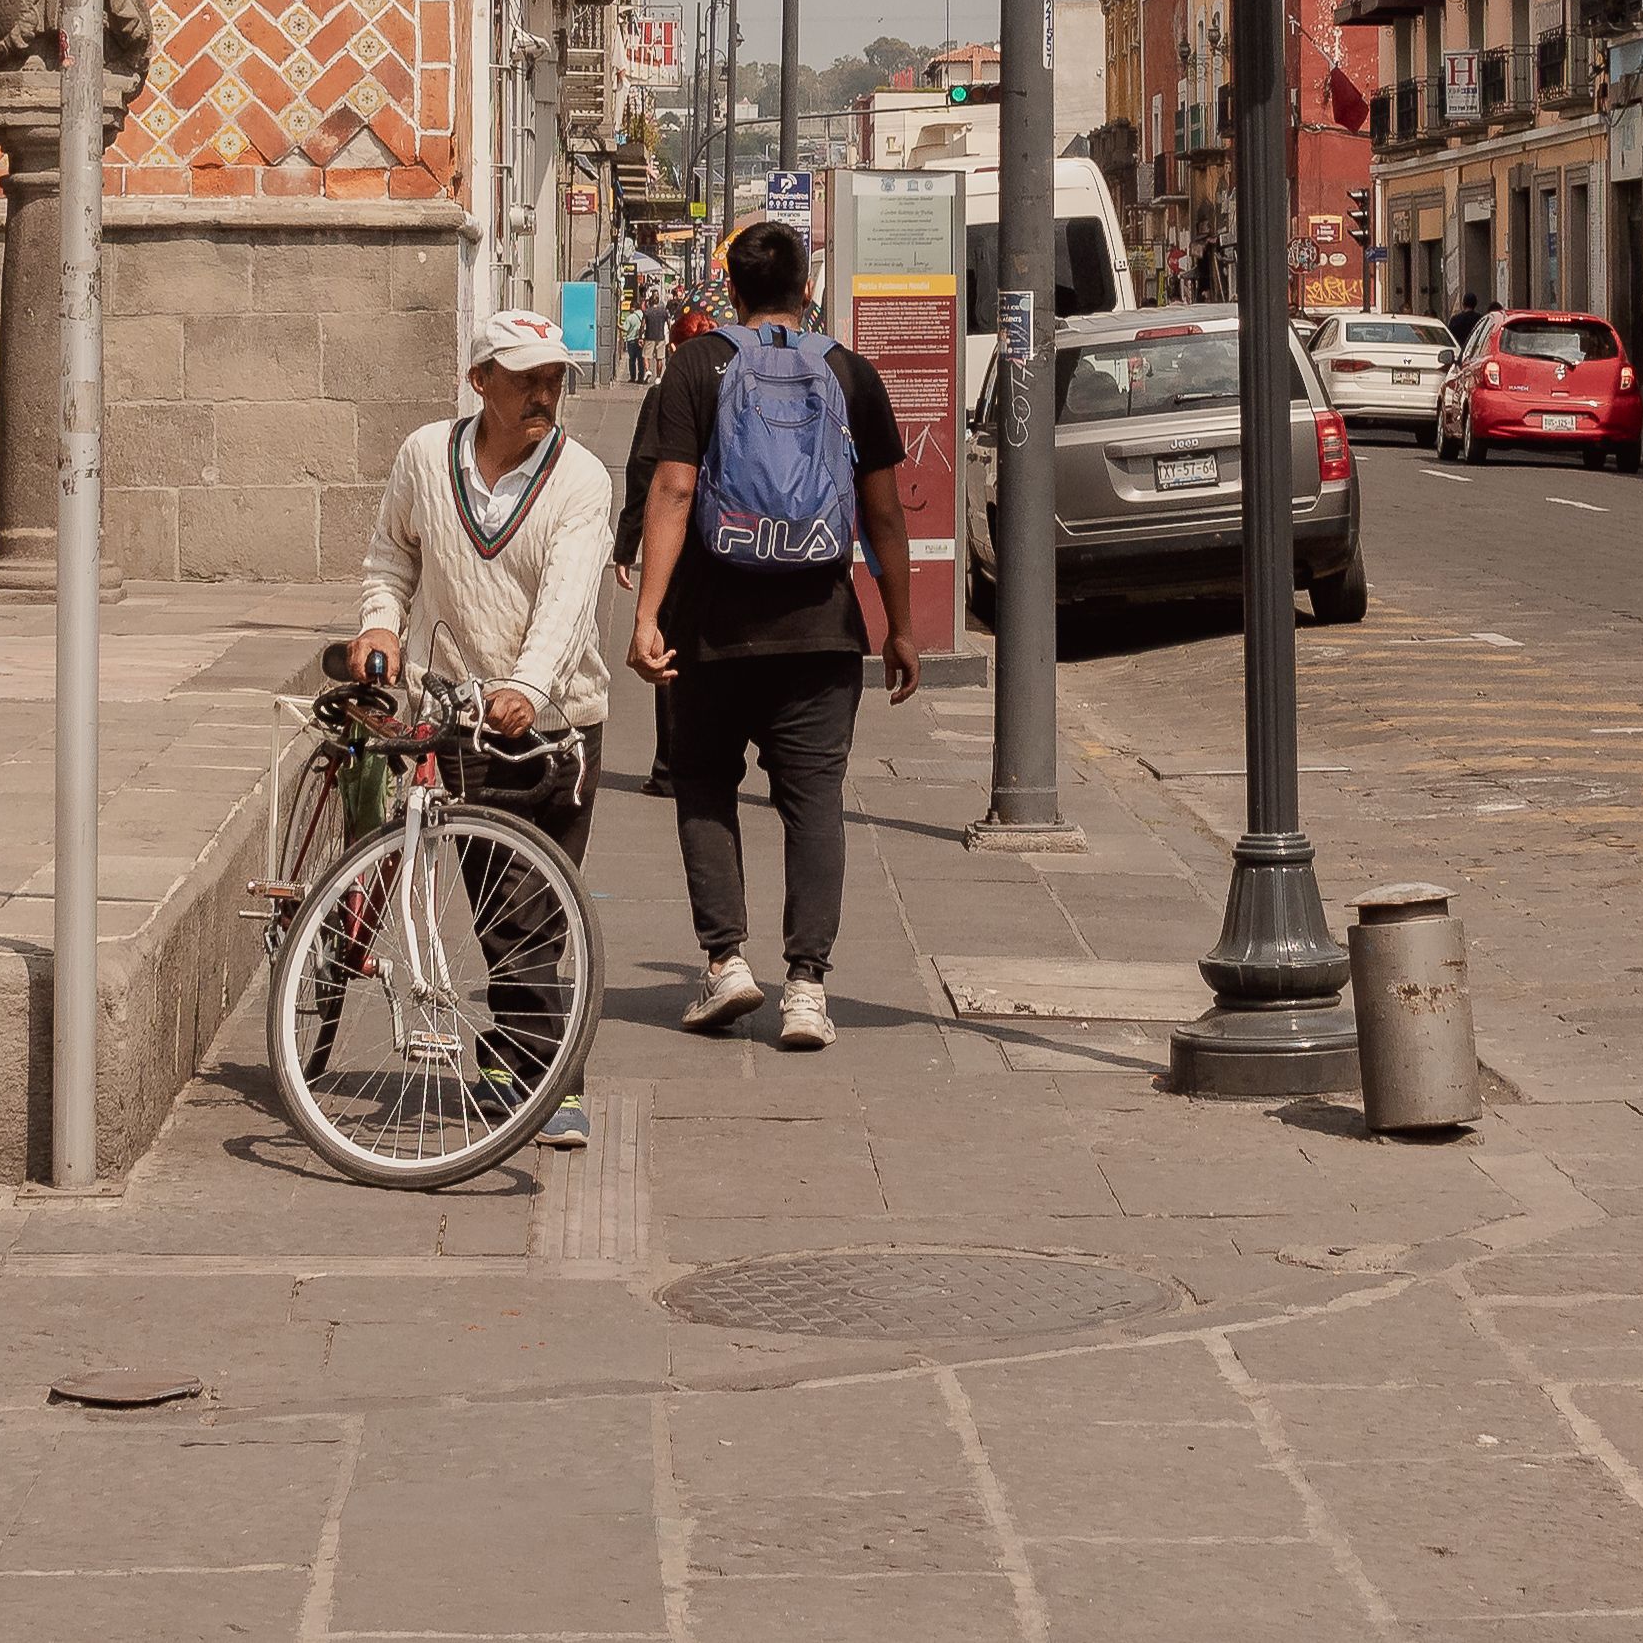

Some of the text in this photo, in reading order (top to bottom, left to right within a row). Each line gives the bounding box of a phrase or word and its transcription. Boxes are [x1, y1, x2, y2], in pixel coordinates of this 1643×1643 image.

[1447, 56, 1477, 86] H
[1170, 438, 1199, 450] Jeep
[718, 512, 839, 561] FILA
